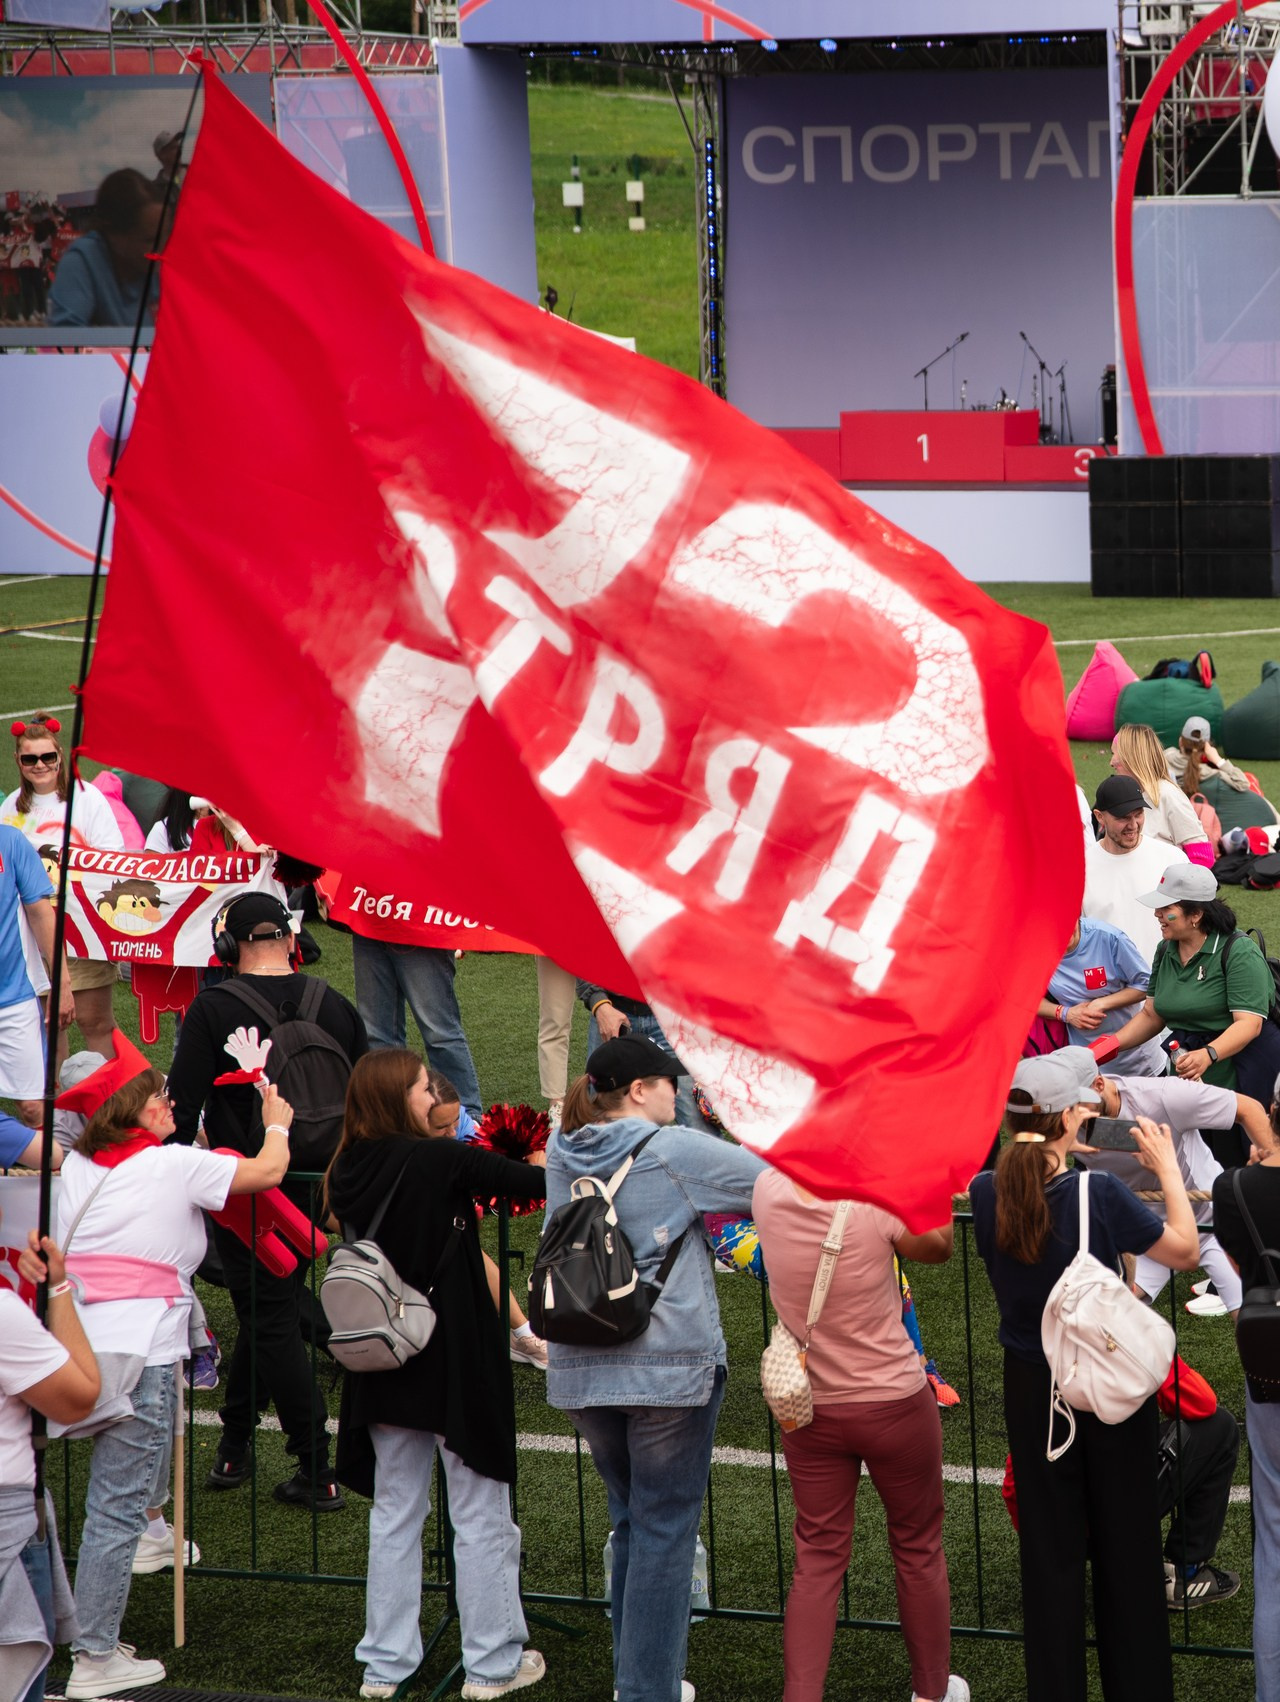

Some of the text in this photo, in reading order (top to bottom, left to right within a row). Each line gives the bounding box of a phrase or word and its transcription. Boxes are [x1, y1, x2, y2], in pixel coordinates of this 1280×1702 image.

[916, 433, 930, 463] 1
[1073, 447, 1097, 477] 3
[349, 886, 414, 921] Тебя
[110, 940, 163, 960] ТЮМЕНЬ
[818, 1268, 830, 1292] LOUIS
